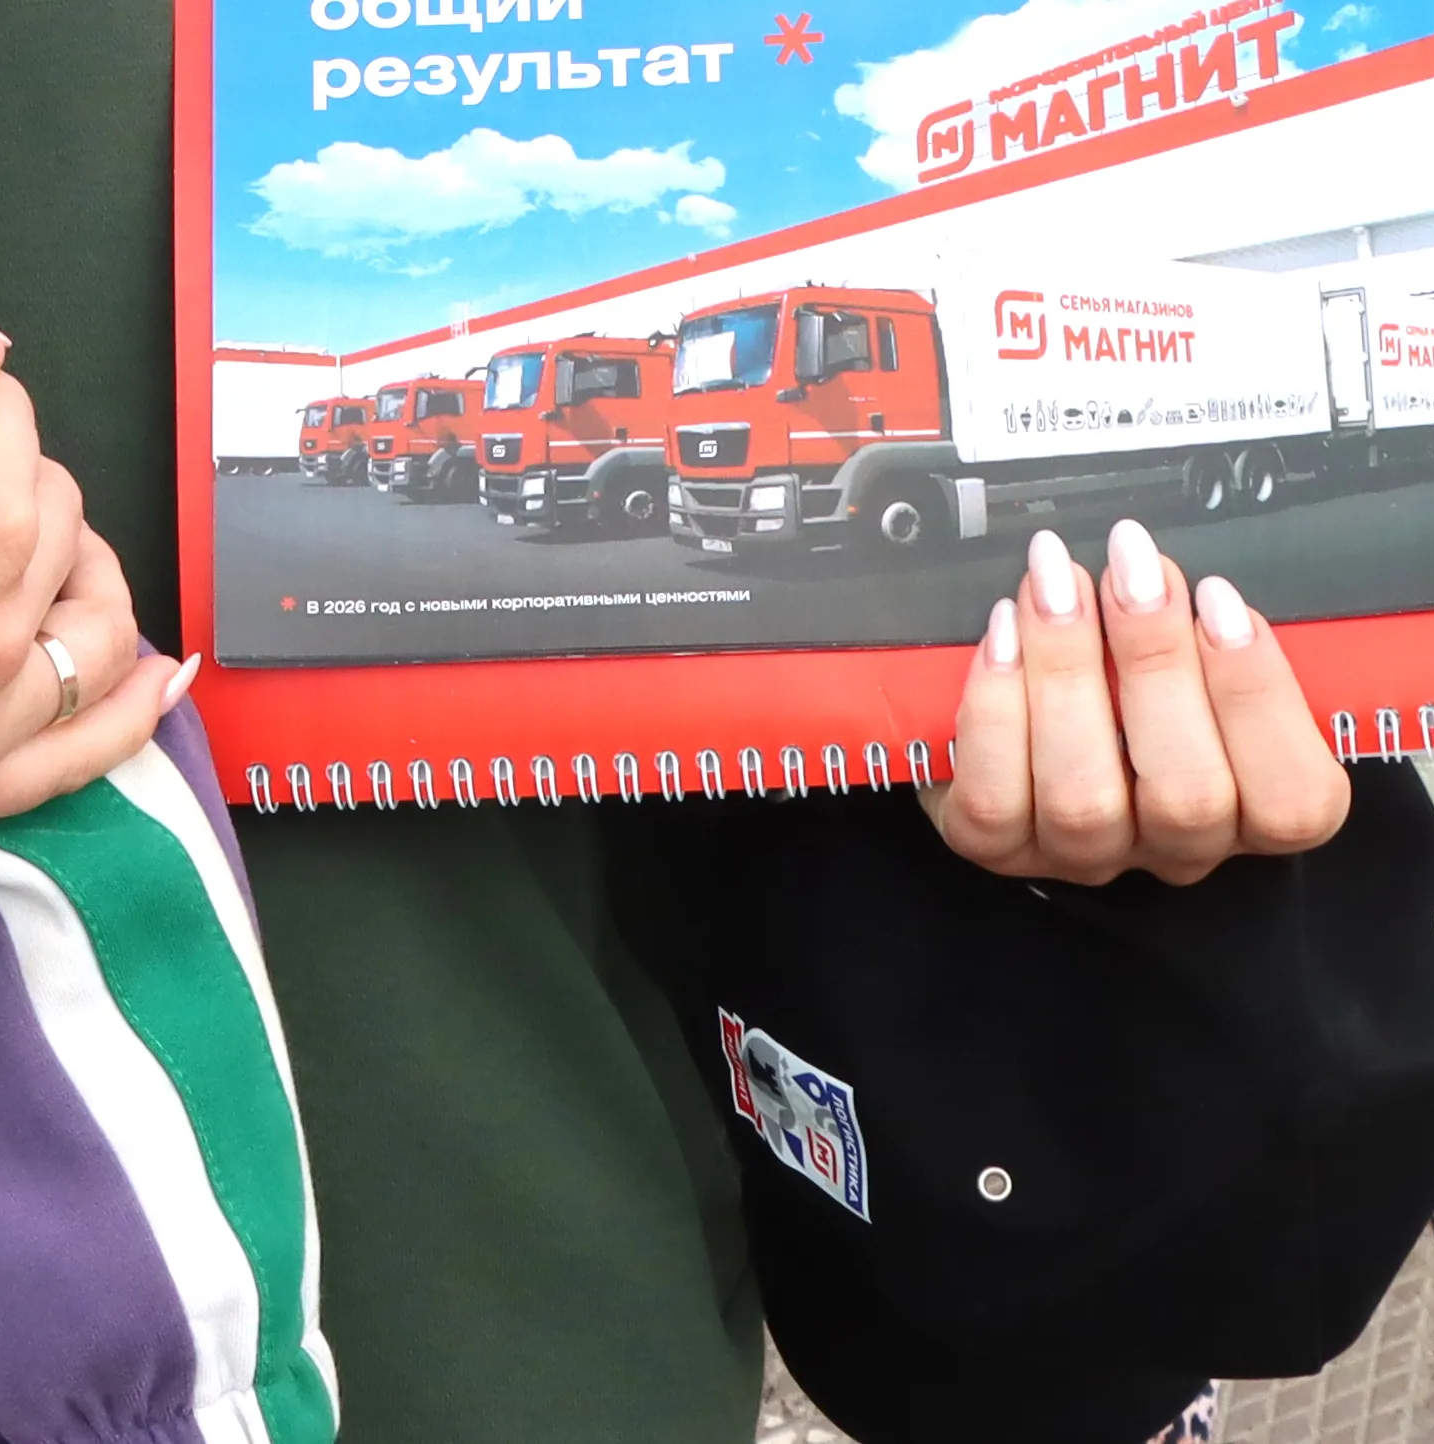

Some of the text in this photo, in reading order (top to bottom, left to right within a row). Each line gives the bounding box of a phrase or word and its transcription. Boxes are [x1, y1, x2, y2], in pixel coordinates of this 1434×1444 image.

[312, 43, 735, 111] результат
[989, 10, 1295, 161] МАГНИТ
[1059, 294, 1195, 319] СЕМЬЯ МАГАЗИНОВ
[1063, 324, 1196, 363] МАГНИТ
[306, 587, 751, 615] В 2026 год с новыми корпоративными ценностями
[831, 1093, 861, 1203] ЛОГИСТИКА
